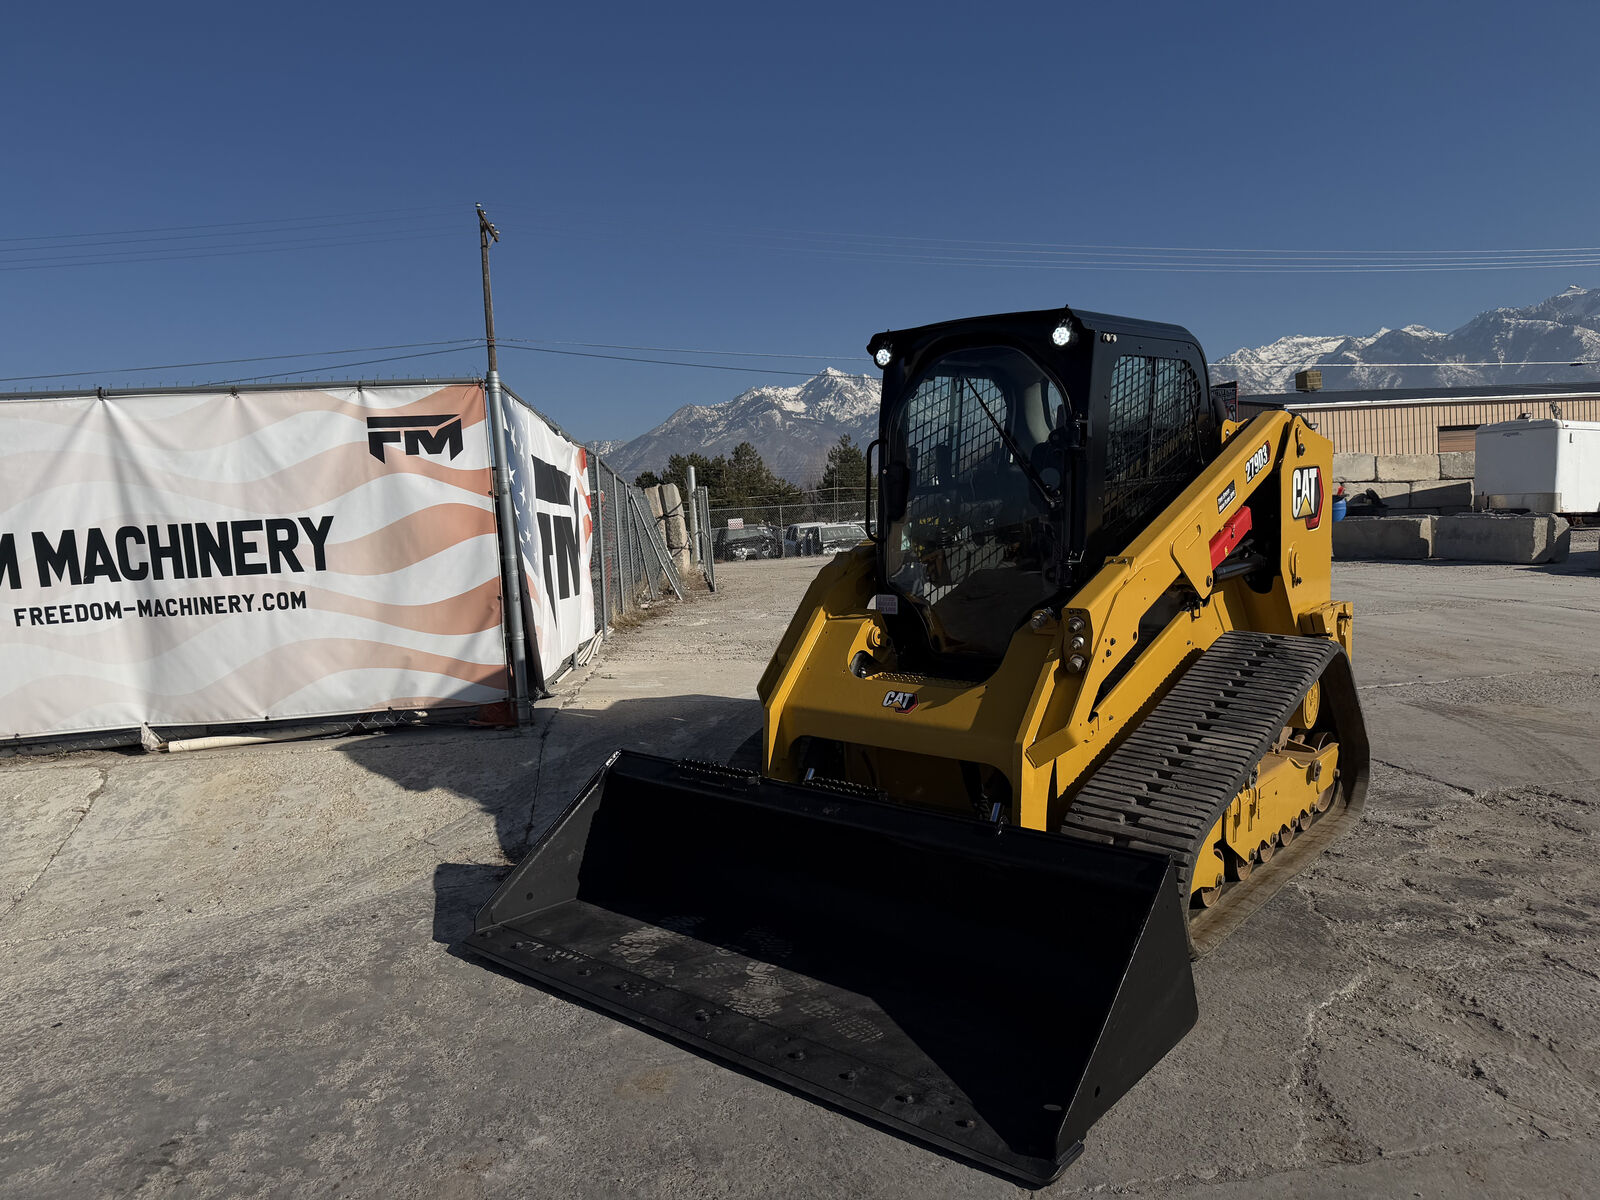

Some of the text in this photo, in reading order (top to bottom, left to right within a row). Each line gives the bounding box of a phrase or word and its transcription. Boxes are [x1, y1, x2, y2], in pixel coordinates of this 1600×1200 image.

[367, 414, 464, 464] FM
[1293, 468, 1317, 518] CAT
[32, 516, 334, 588] MACHINERY
[14, 590, 307, 627] FREEDOM-MACHINERY.COM
[883, 691, 913, 709] CAT
